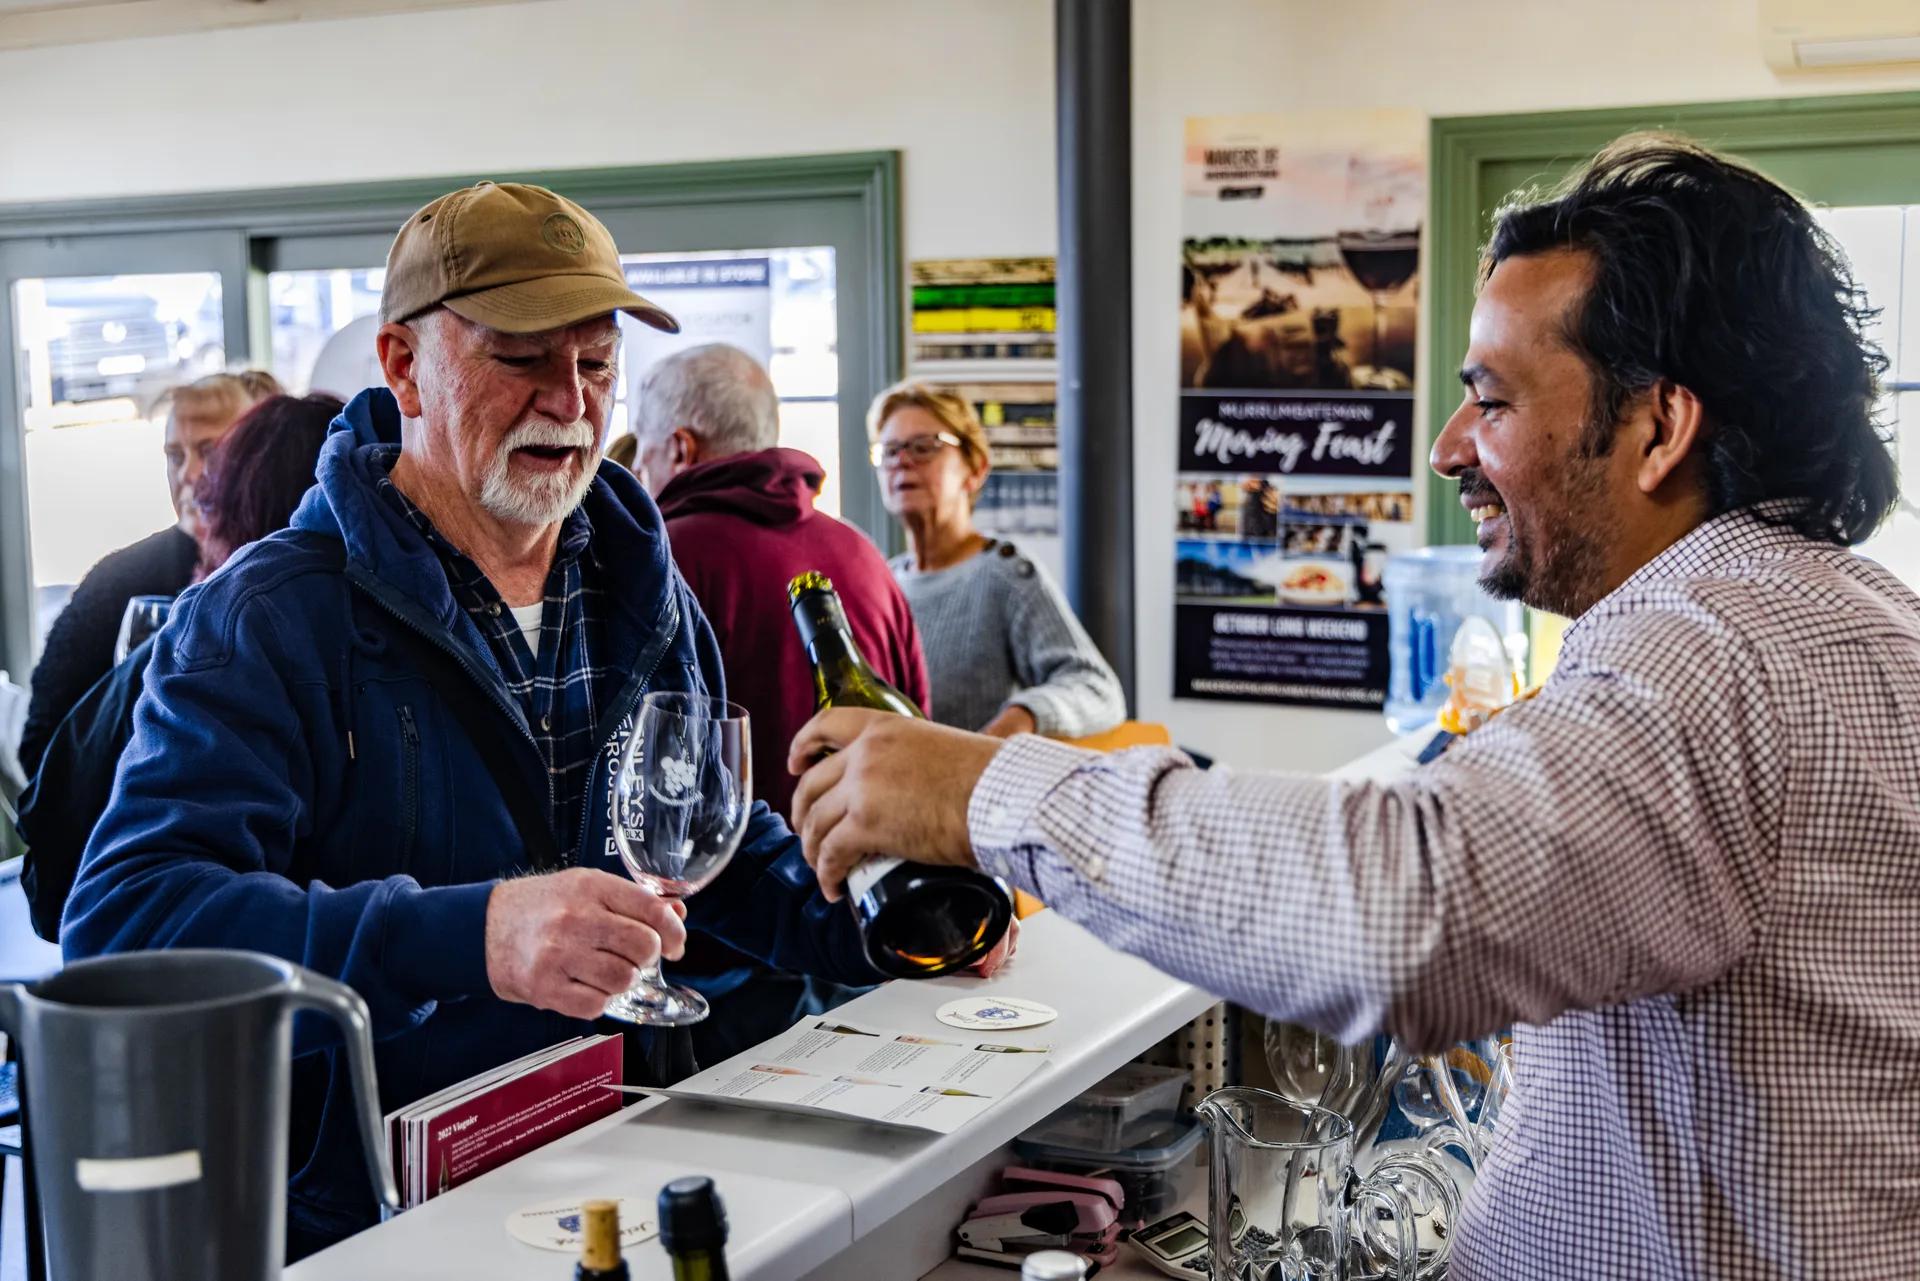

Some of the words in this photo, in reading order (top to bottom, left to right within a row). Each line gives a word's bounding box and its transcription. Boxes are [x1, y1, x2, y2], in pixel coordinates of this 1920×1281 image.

[1194, 418, 1304, 472] Moving
[1311, 420, 1396, 465] Feast
[437, 1127, 452, 1141] 2022
[453, 1115, 479, 1133] Viognier
